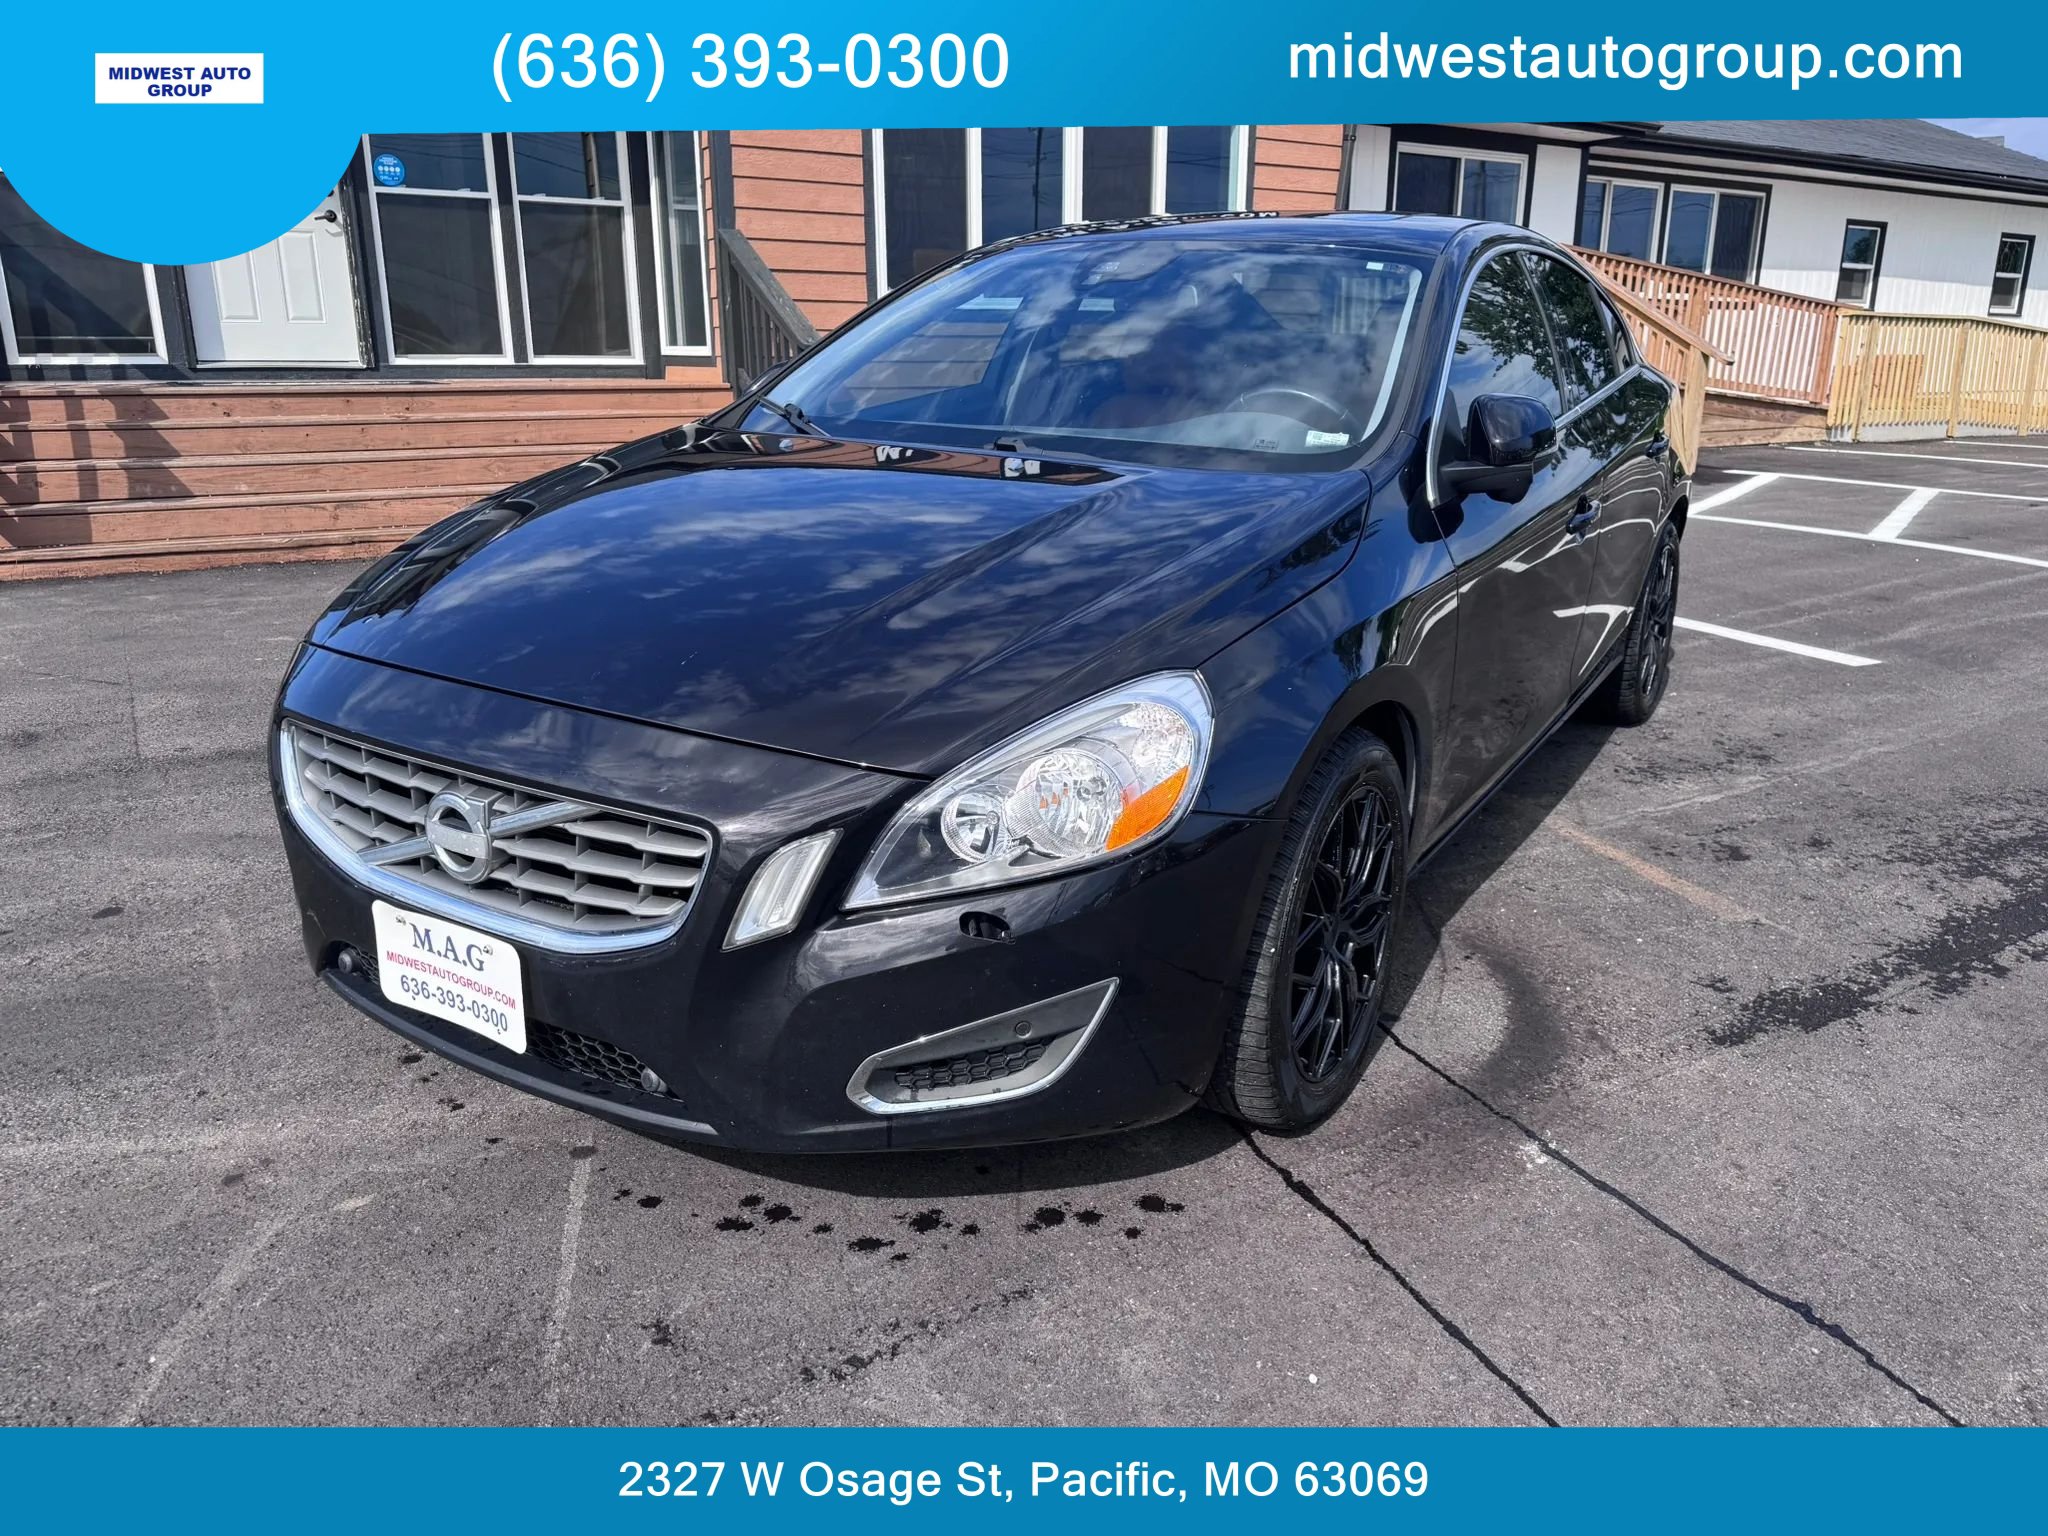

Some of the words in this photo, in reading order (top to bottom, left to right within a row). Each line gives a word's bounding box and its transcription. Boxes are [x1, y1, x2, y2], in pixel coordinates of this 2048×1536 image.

[409, 922, 485, 972] M.A.G
[386, 950, 516, 1010] MIDWESTAUTOGROUP.COM
[401, 974, 508, 1032] 636-393-0300
